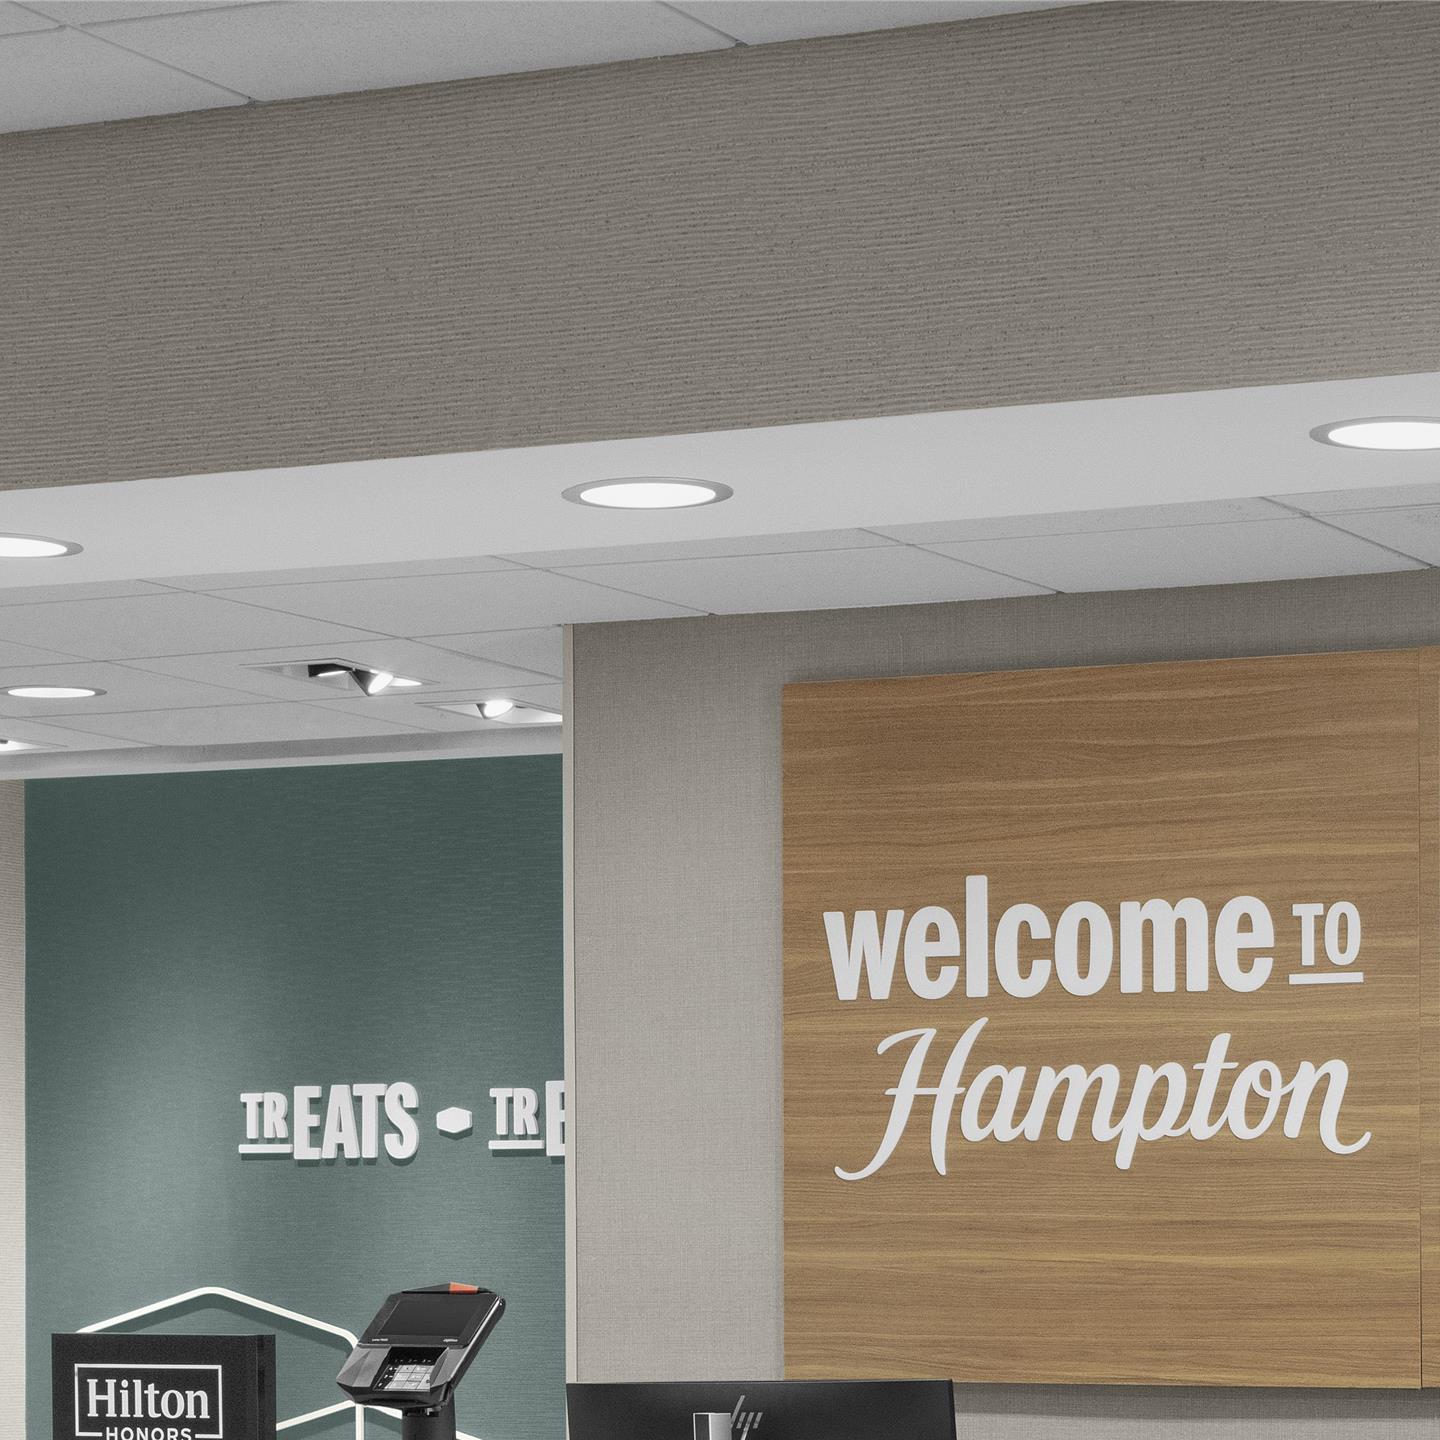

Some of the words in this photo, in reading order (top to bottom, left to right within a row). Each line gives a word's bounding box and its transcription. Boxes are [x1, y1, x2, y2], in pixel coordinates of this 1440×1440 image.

[822, 874, 1275, 1000] welcome
[1291, 901, 1362, 968] TO
[239, 1081, 420, 1160] TREATS
[834, 1016, 1372, 1181] Hampton
[86, 1378, 211, 1421] Hilton
